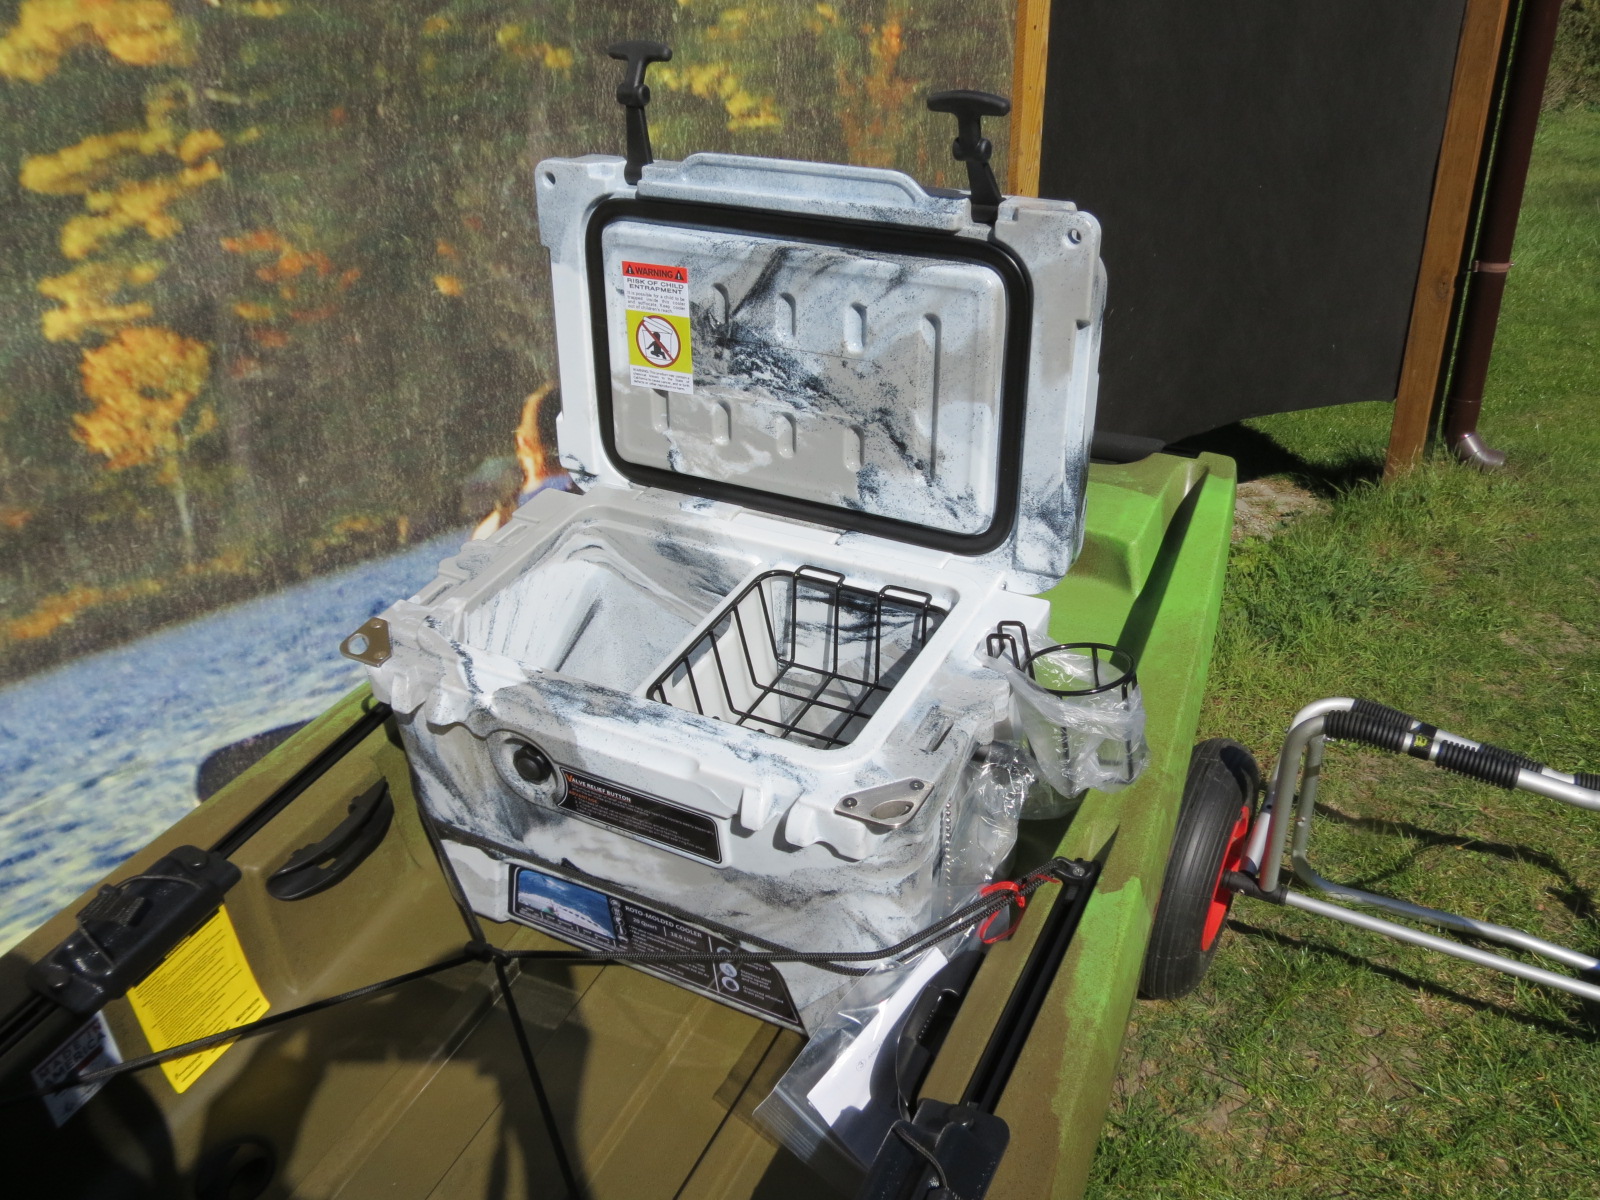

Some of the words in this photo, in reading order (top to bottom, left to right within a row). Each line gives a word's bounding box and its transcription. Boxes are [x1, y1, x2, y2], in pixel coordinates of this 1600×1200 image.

[635, 266, 673, 278] WARNING
[629, 284, 682, 294] ENTRAPMENT
[565, 773, 585, 787] VALVE
[586, 783, 606, 794] RELIEF
[606, 789, 632, 802] BUTTON
[625, 905, 674, 928] ROTO-MOLDED
[675, 923, 703, 939] COOLER
[641, 920, 658, 931] Quart
[670, 931, 683, 940] 18.9
[683, 936, 697, 945] Liter
